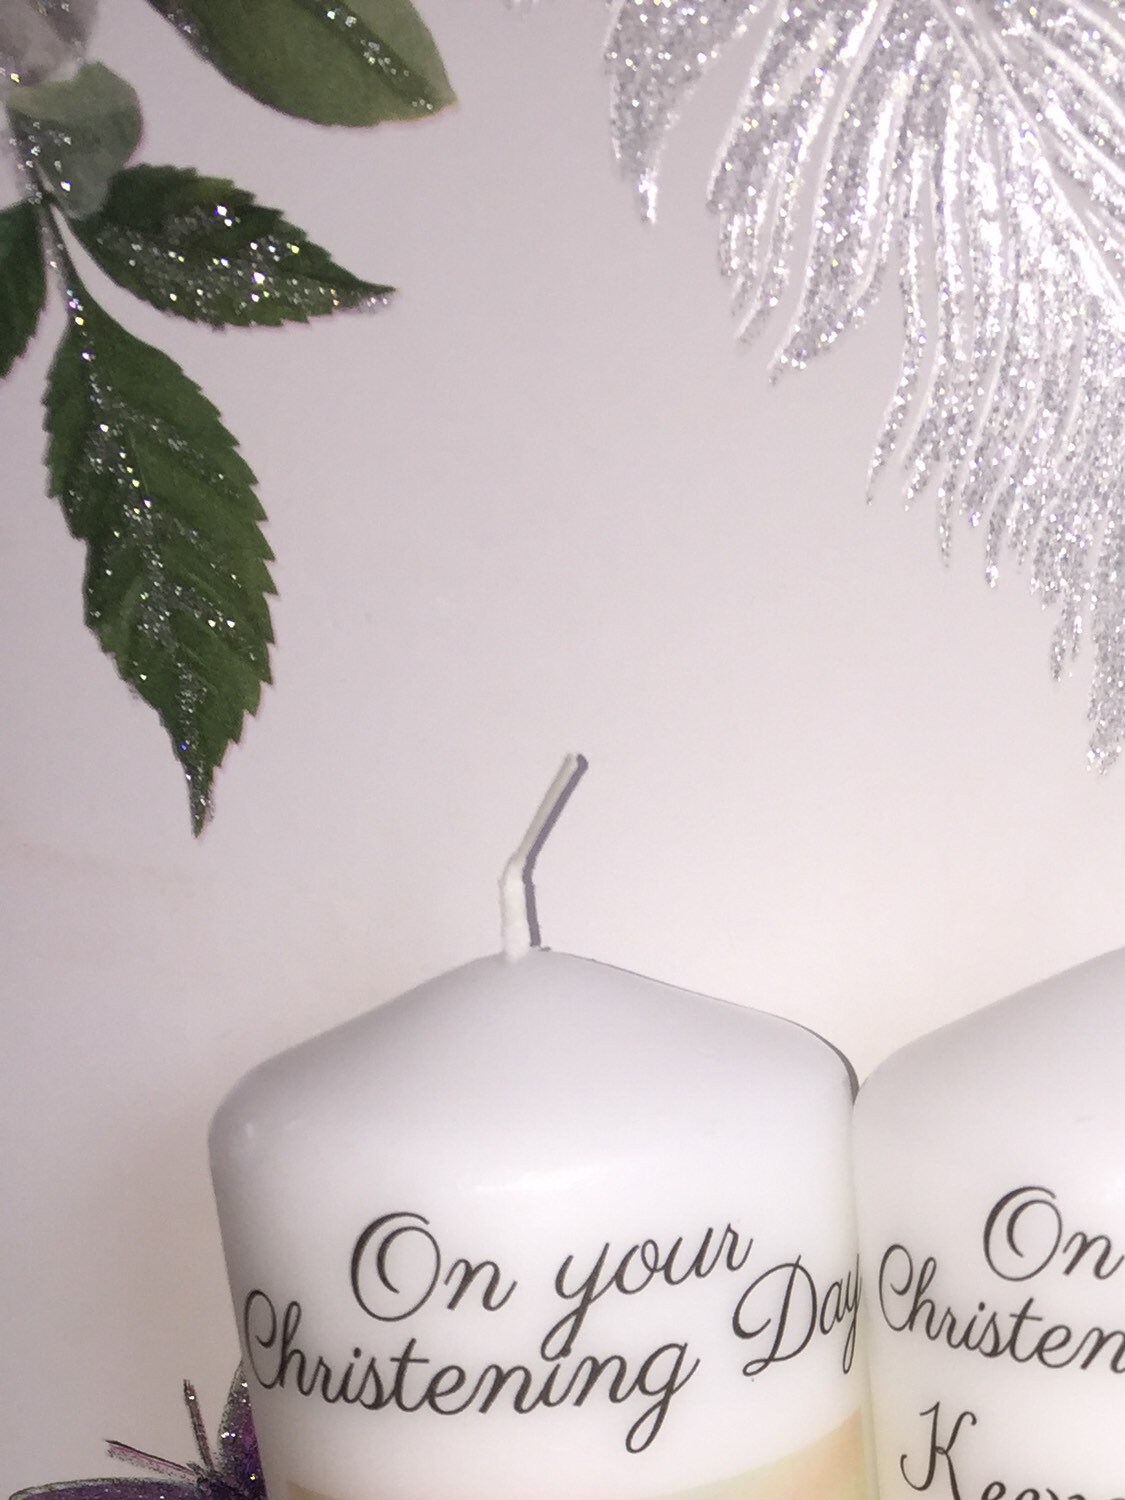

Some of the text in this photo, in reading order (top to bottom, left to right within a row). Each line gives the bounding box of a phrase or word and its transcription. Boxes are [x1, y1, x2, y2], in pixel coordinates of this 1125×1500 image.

[351, 1212, 753, 1361] On your
[983, 1186, 1125, 1281] On
[244, 1254, 862, 1452] Christening Day
